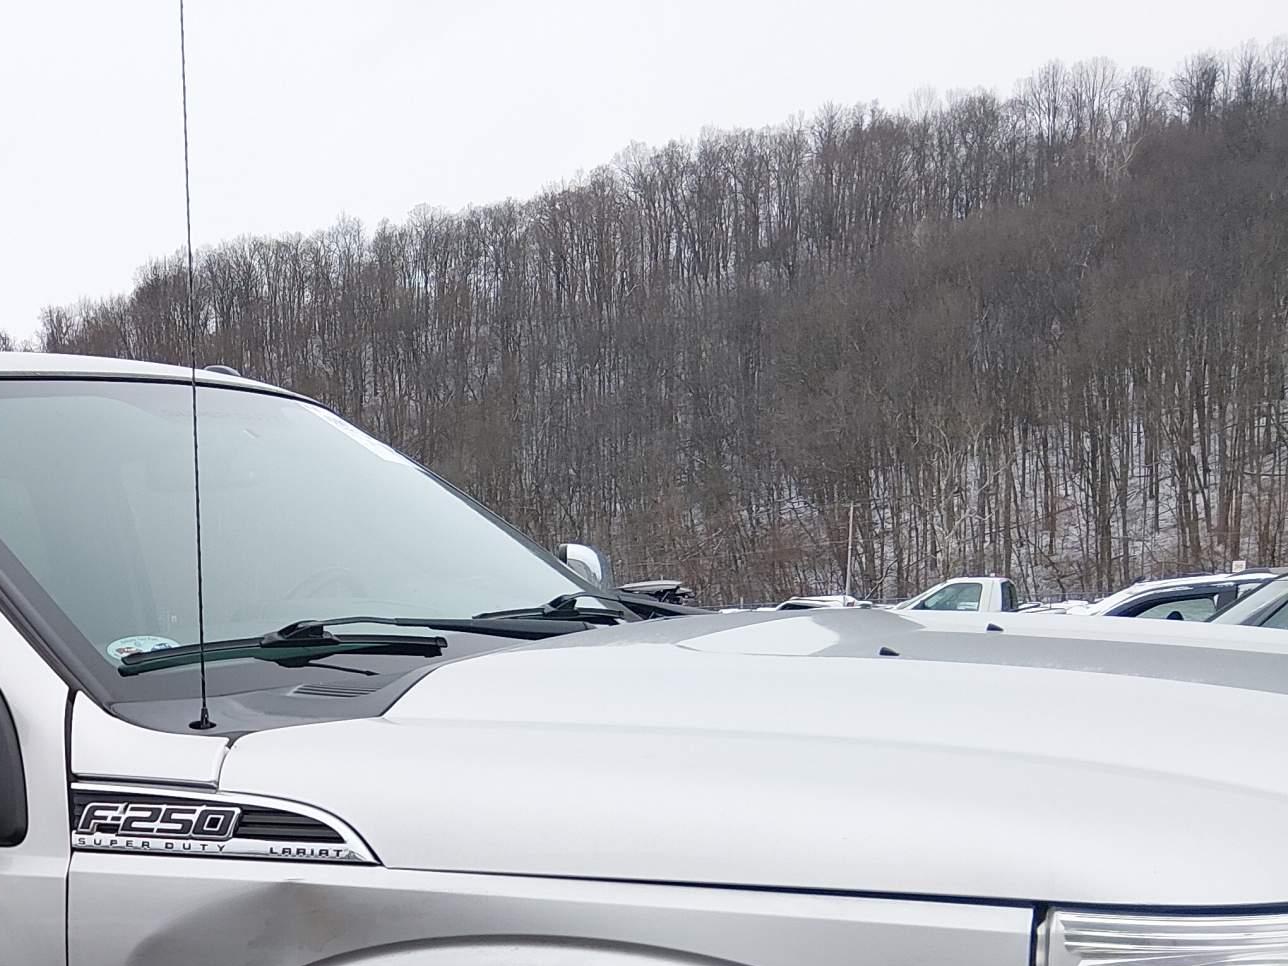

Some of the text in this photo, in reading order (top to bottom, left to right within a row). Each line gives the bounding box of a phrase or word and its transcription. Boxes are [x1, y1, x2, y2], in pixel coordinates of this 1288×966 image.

[76, 801, 241, 840] F-250
[77, 838, 226, 852] SUPER DUTY
[269, 846, 342, 858] LARIAT
